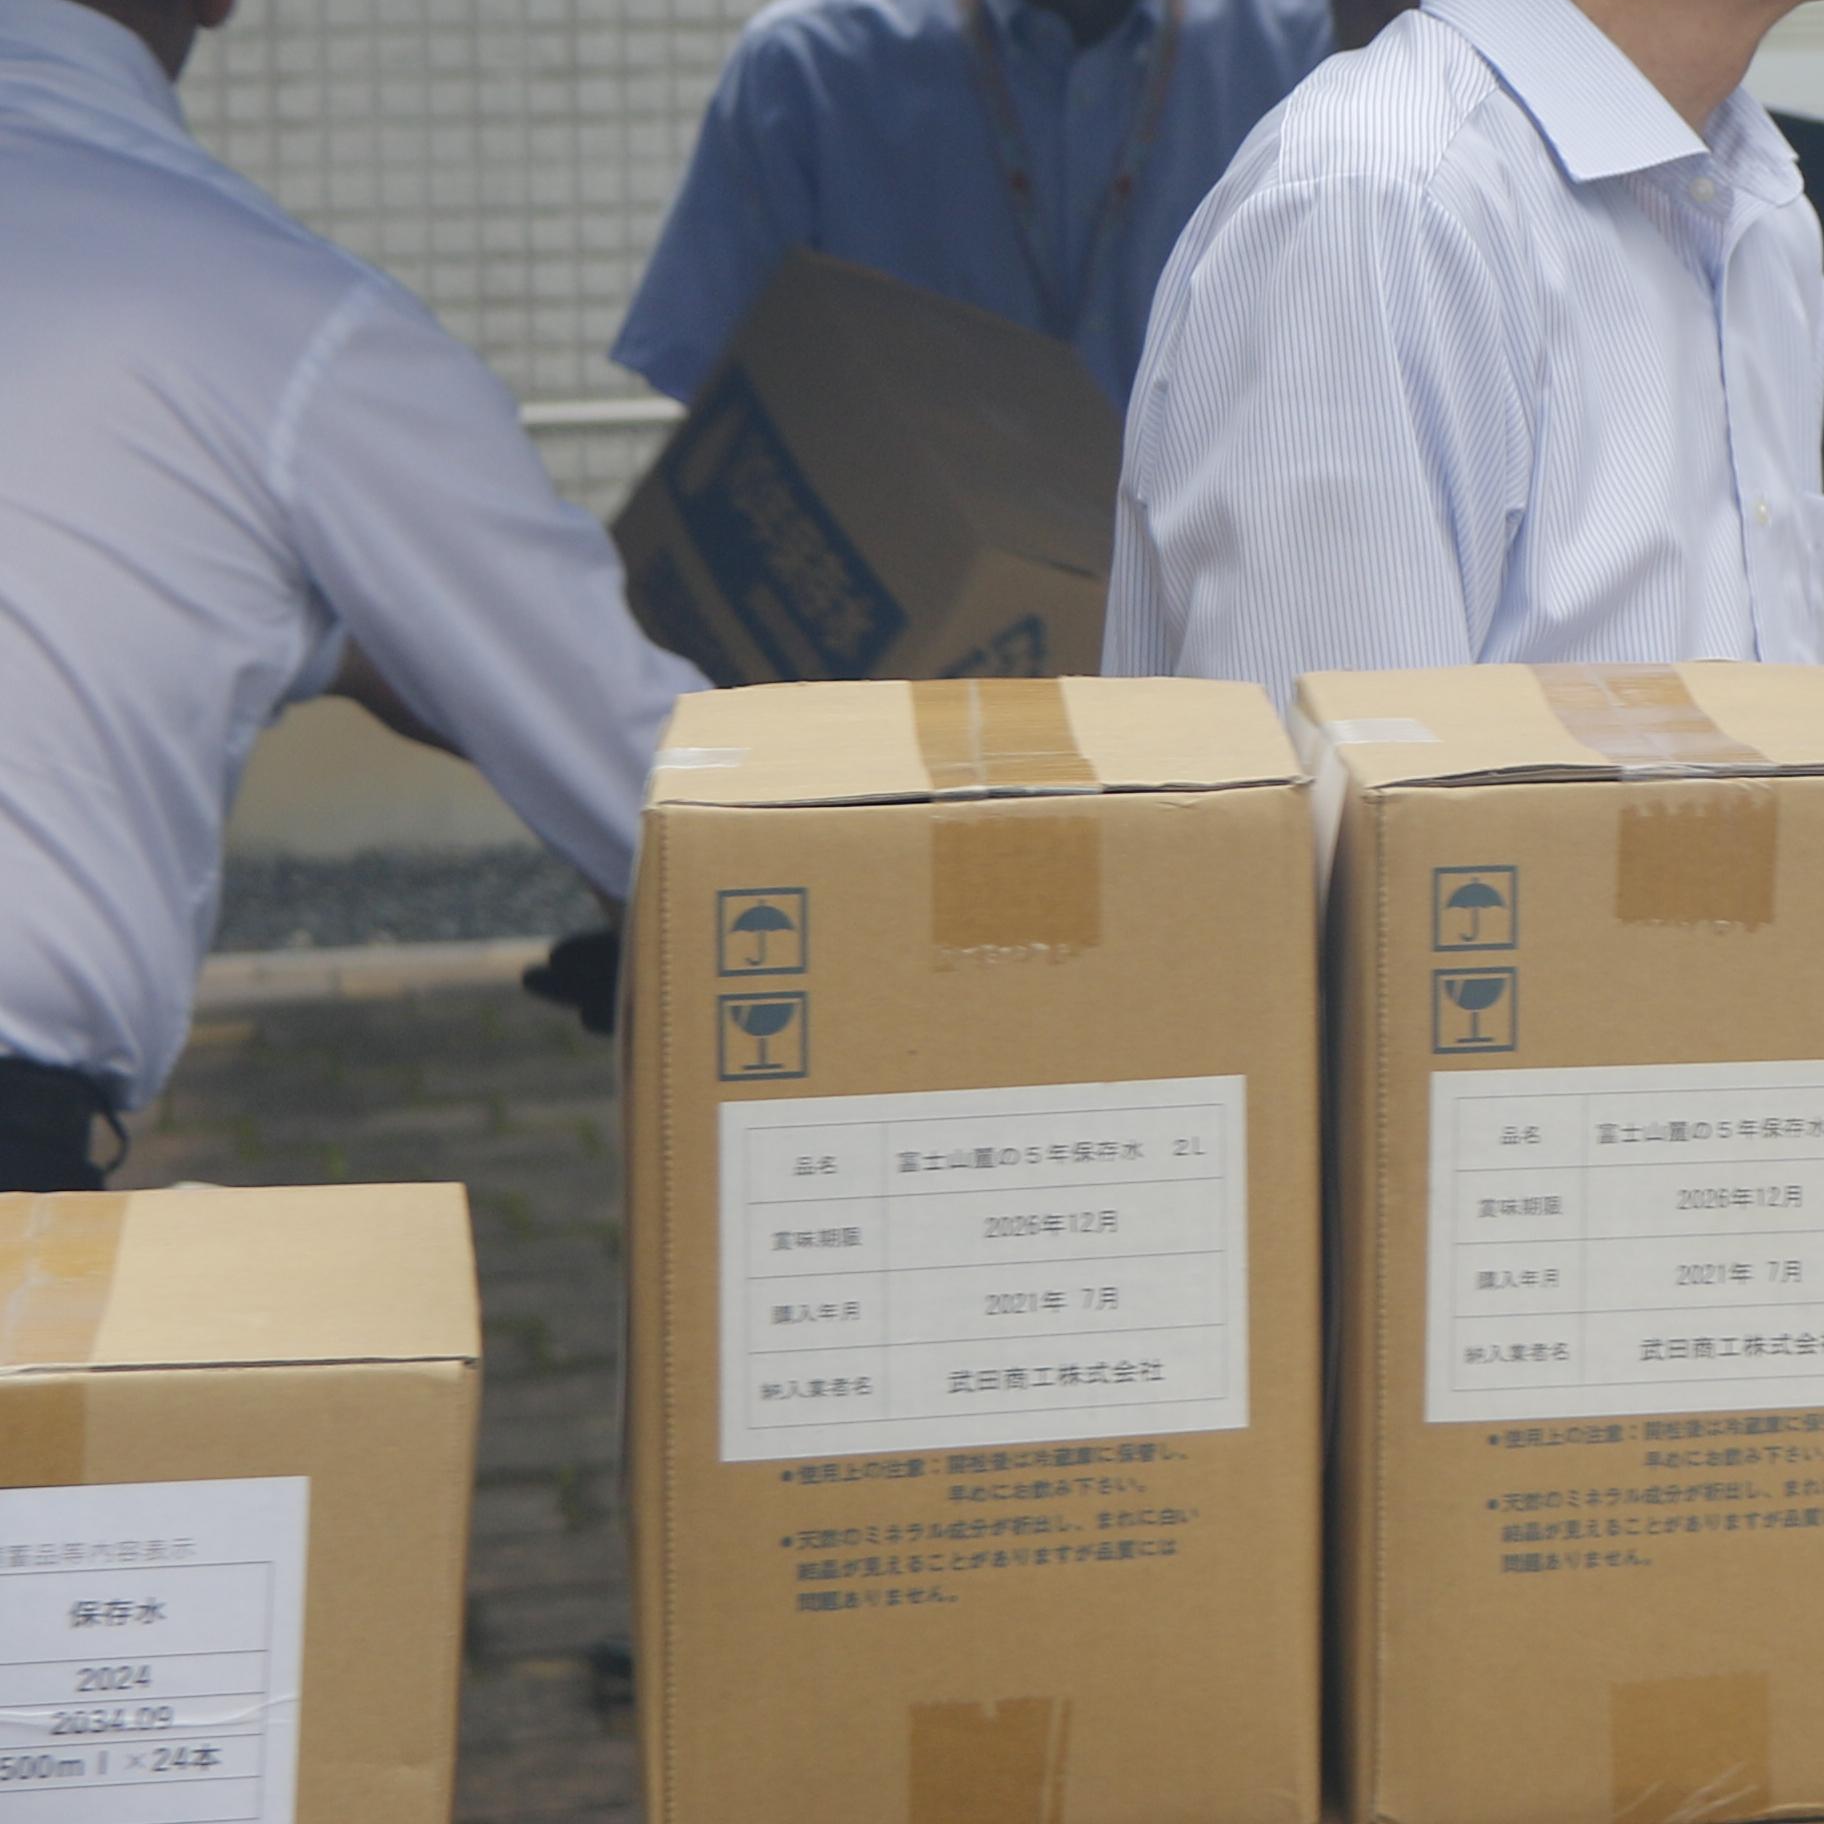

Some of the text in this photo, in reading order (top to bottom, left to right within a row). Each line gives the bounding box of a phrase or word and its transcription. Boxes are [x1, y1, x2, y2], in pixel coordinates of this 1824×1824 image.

[1499, 1124, 1543, 1146] 品名
[792, 1154, 838, 1176] 品名
[1677, 1184, 1804, 1211] 2026年12月
[983, 1209, 1120, 1239] 2026年12月
[1676, 1258, 1804, 1286] 2021年 7月
[983, 1285, 1120, 1317] 2021年 7月
[67, 1596, 168, 1629] 保存水
[74, 1664, 153, 1693] 2024
